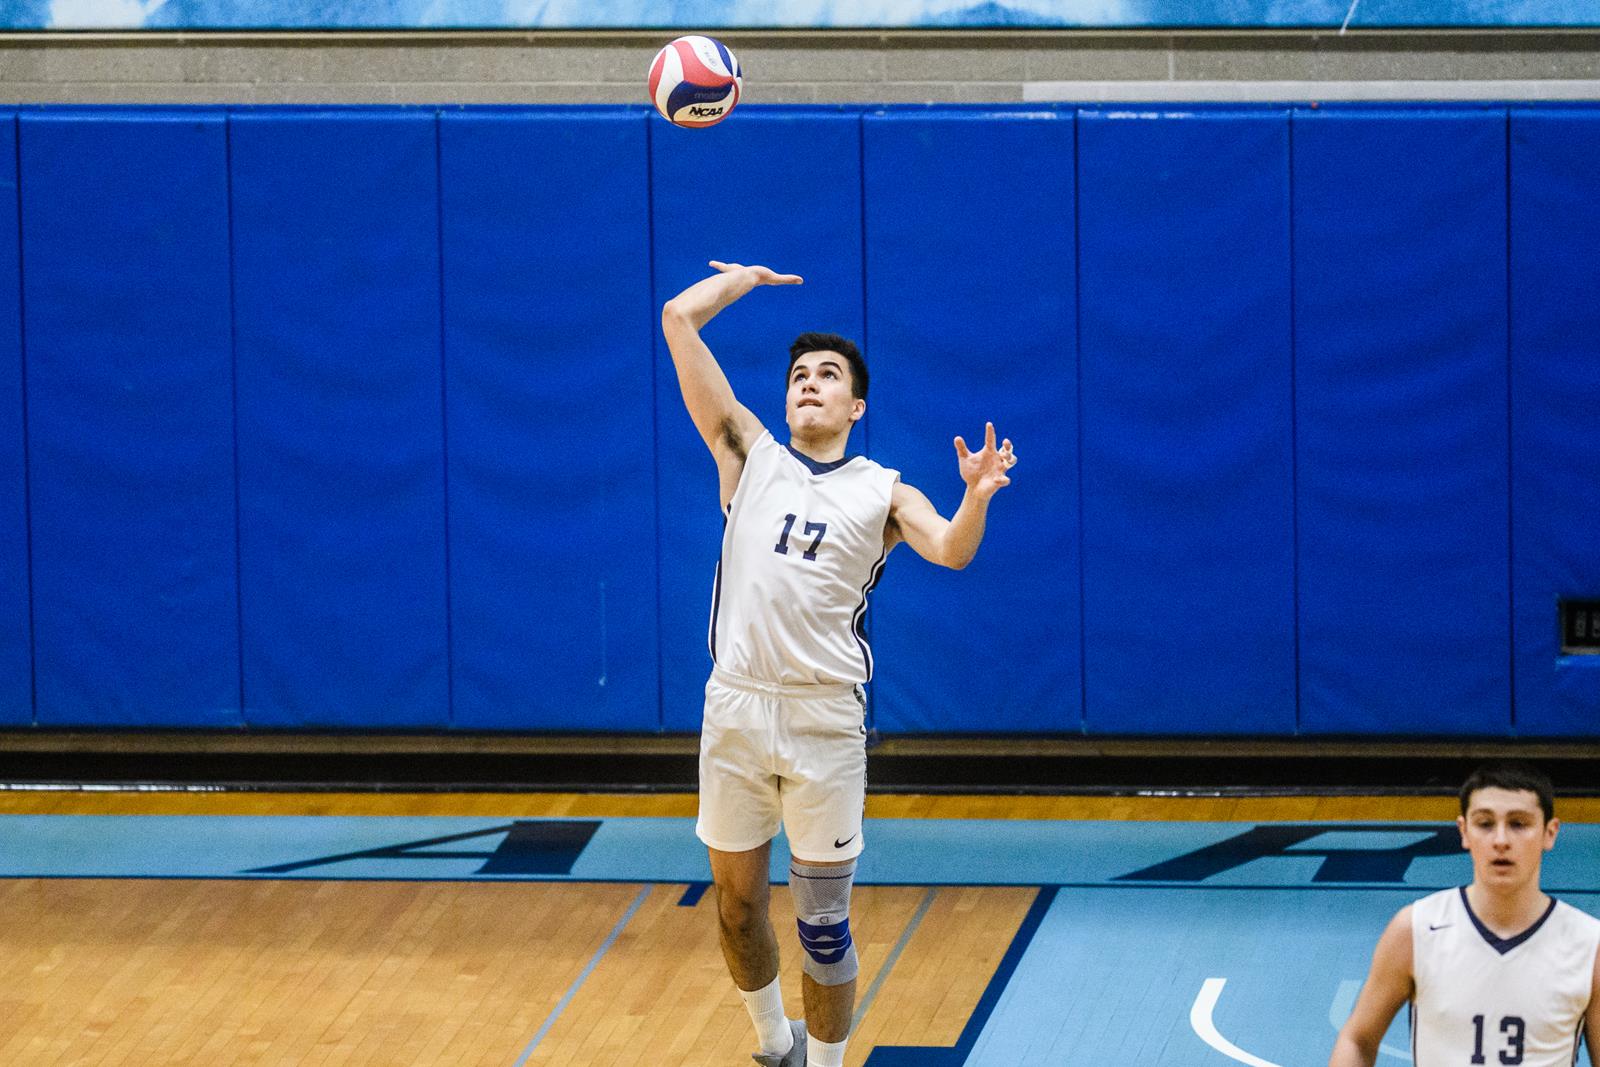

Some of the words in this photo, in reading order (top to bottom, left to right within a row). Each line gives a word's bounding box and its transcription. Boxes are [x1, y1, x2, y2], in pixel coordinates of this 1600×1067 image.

[689, 106, 723, 116] NCAA
[774, 513, 828, 561] 17
[1470, 1014, 1526, 1066] 13
